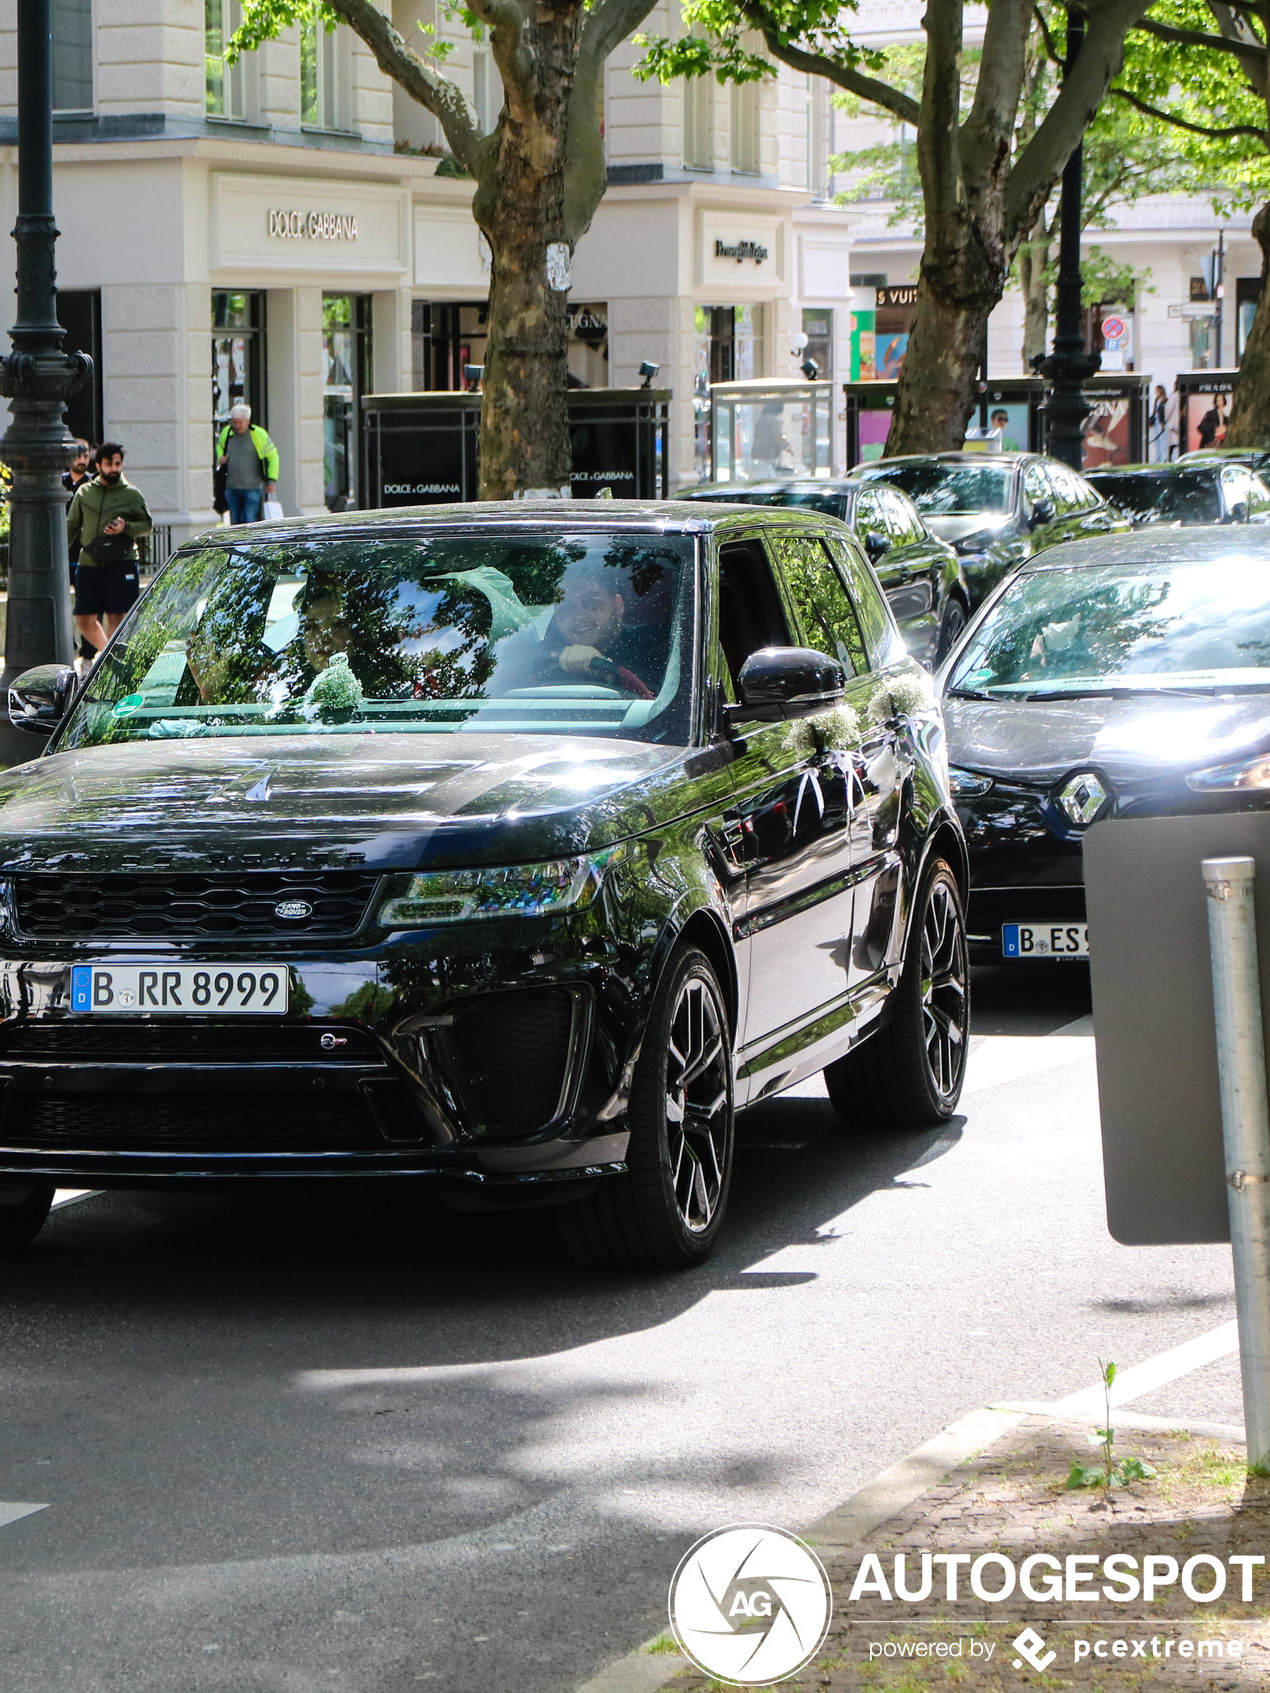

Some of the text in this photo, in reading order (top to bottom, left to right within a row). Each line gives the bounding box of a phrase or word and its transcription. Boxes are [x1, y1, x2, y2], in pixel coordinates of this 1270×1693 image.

[268, 209, 303, 238] DOLCE
[307, 211, 357, 240] GABBANA
[570, 472, 589, 481] OLCE
[593, 471, 635, 481] GABBANA
[383, 484, 411, 495] DOLCE
[416, 484, 461, 494] GABBANA
[1020, 928, 1034, 953] B
[78, 993, 86, 1003] D
[93, 972, 280, 1006] B RR 8999
